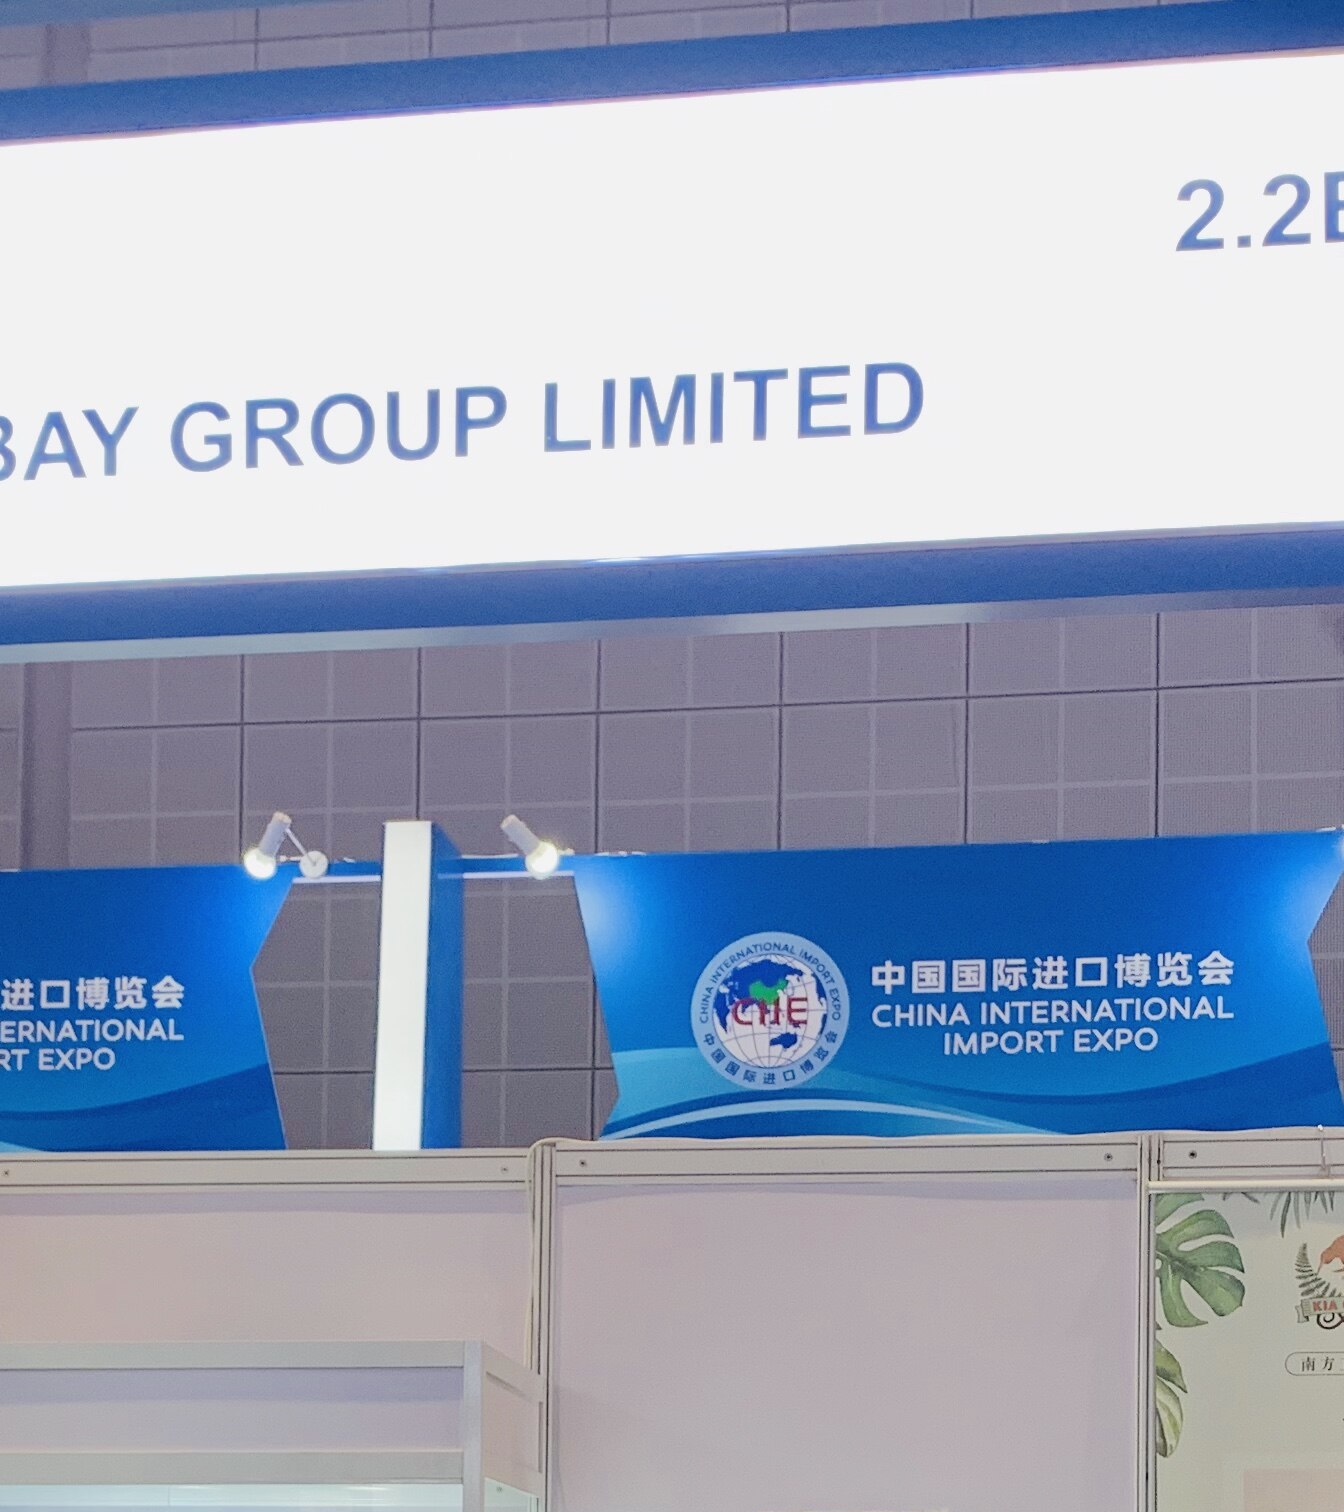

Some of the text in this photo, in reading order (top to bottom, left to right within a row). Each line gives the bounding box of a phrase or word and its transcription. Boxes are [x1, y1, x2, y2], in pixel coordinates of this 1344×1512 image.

[168, 383, 509, 474] GROUP
[541, 360, 926, 454] LIMITED
[699, 941, 842, 1025] CHINA INTERNATIONAL IMPORT EXPO
[871, 950, 1236, 995] 中国国际进口博览会
[871, 994, 1236, 1029] CHINA INTERNATIONAL
[942, 1025, 1160, 1056] IMPORT EXPO
[37, 1046, 116, 1072] EXPO
[1312, 1300, 1341, 1314] KIA
